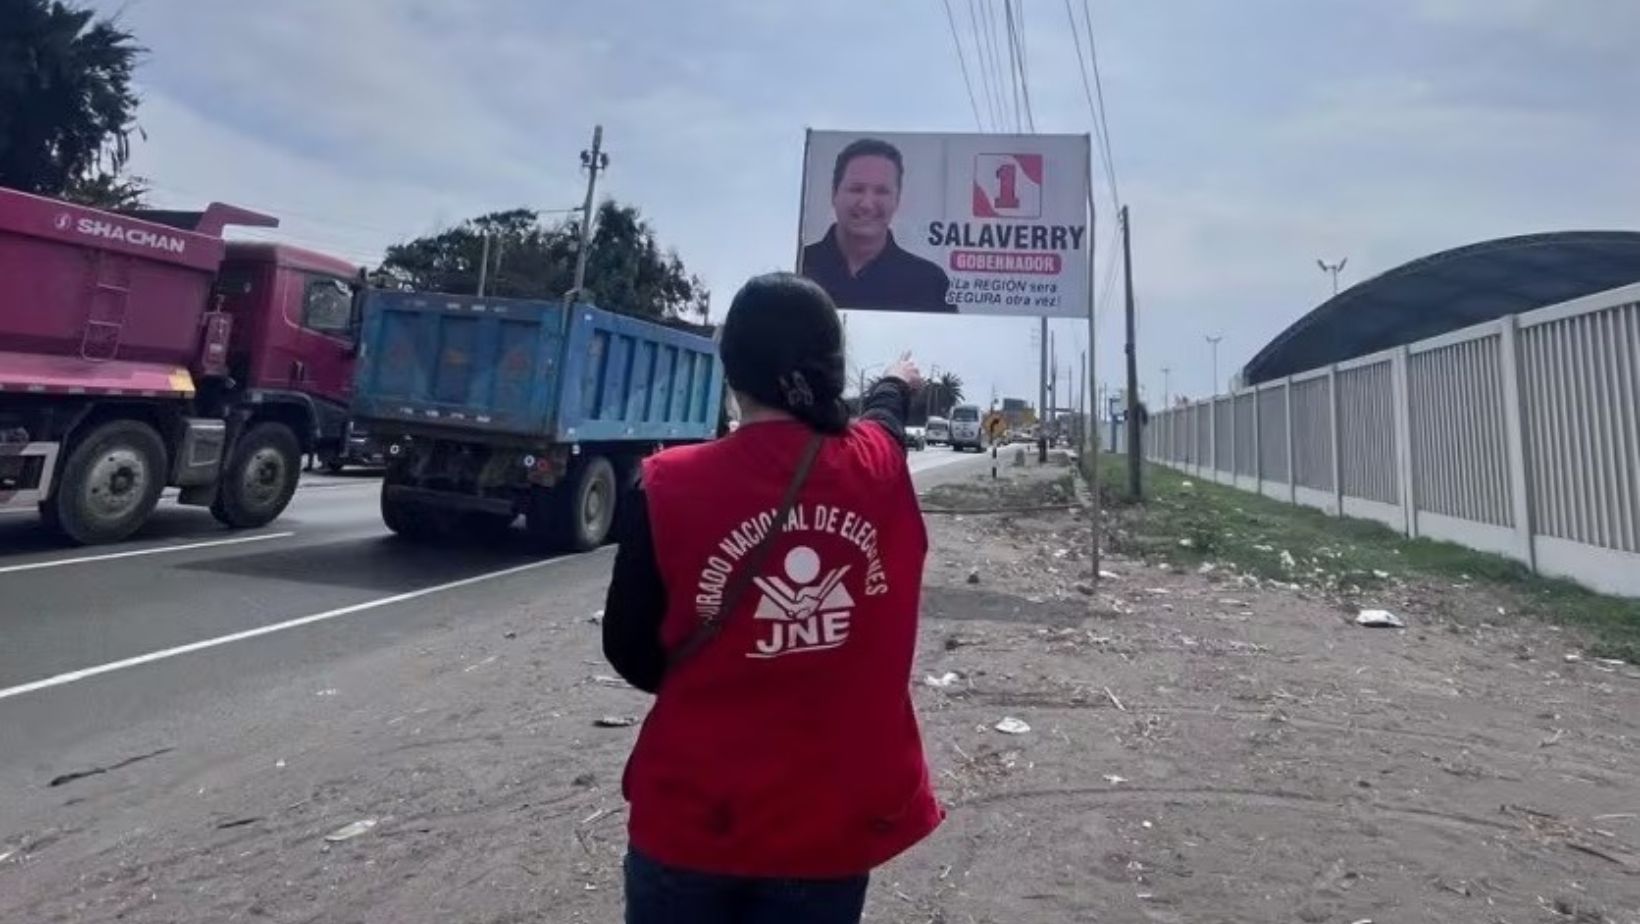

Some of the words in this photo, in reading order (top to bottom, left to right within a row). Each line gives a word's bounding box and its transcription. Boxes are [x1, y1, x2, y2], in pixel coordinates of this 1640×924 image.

[994, 164, 1019, 209] 1
[77, 218, 185, 253] SHACMAN
[928, 221, 1085, 250] SALAVERRY
[956, 253, 1055, 272] GOBERNADOR
[947, 291, 1001, 305] SEGURA
[1006, 294, 1031, 306] otra
[1034, 295, 1061, 307] vez!
[718, 503, 809, 560] NACIOAL
[814, 504, 840, 533] DE
[756, 611, 851, 653] JNE
